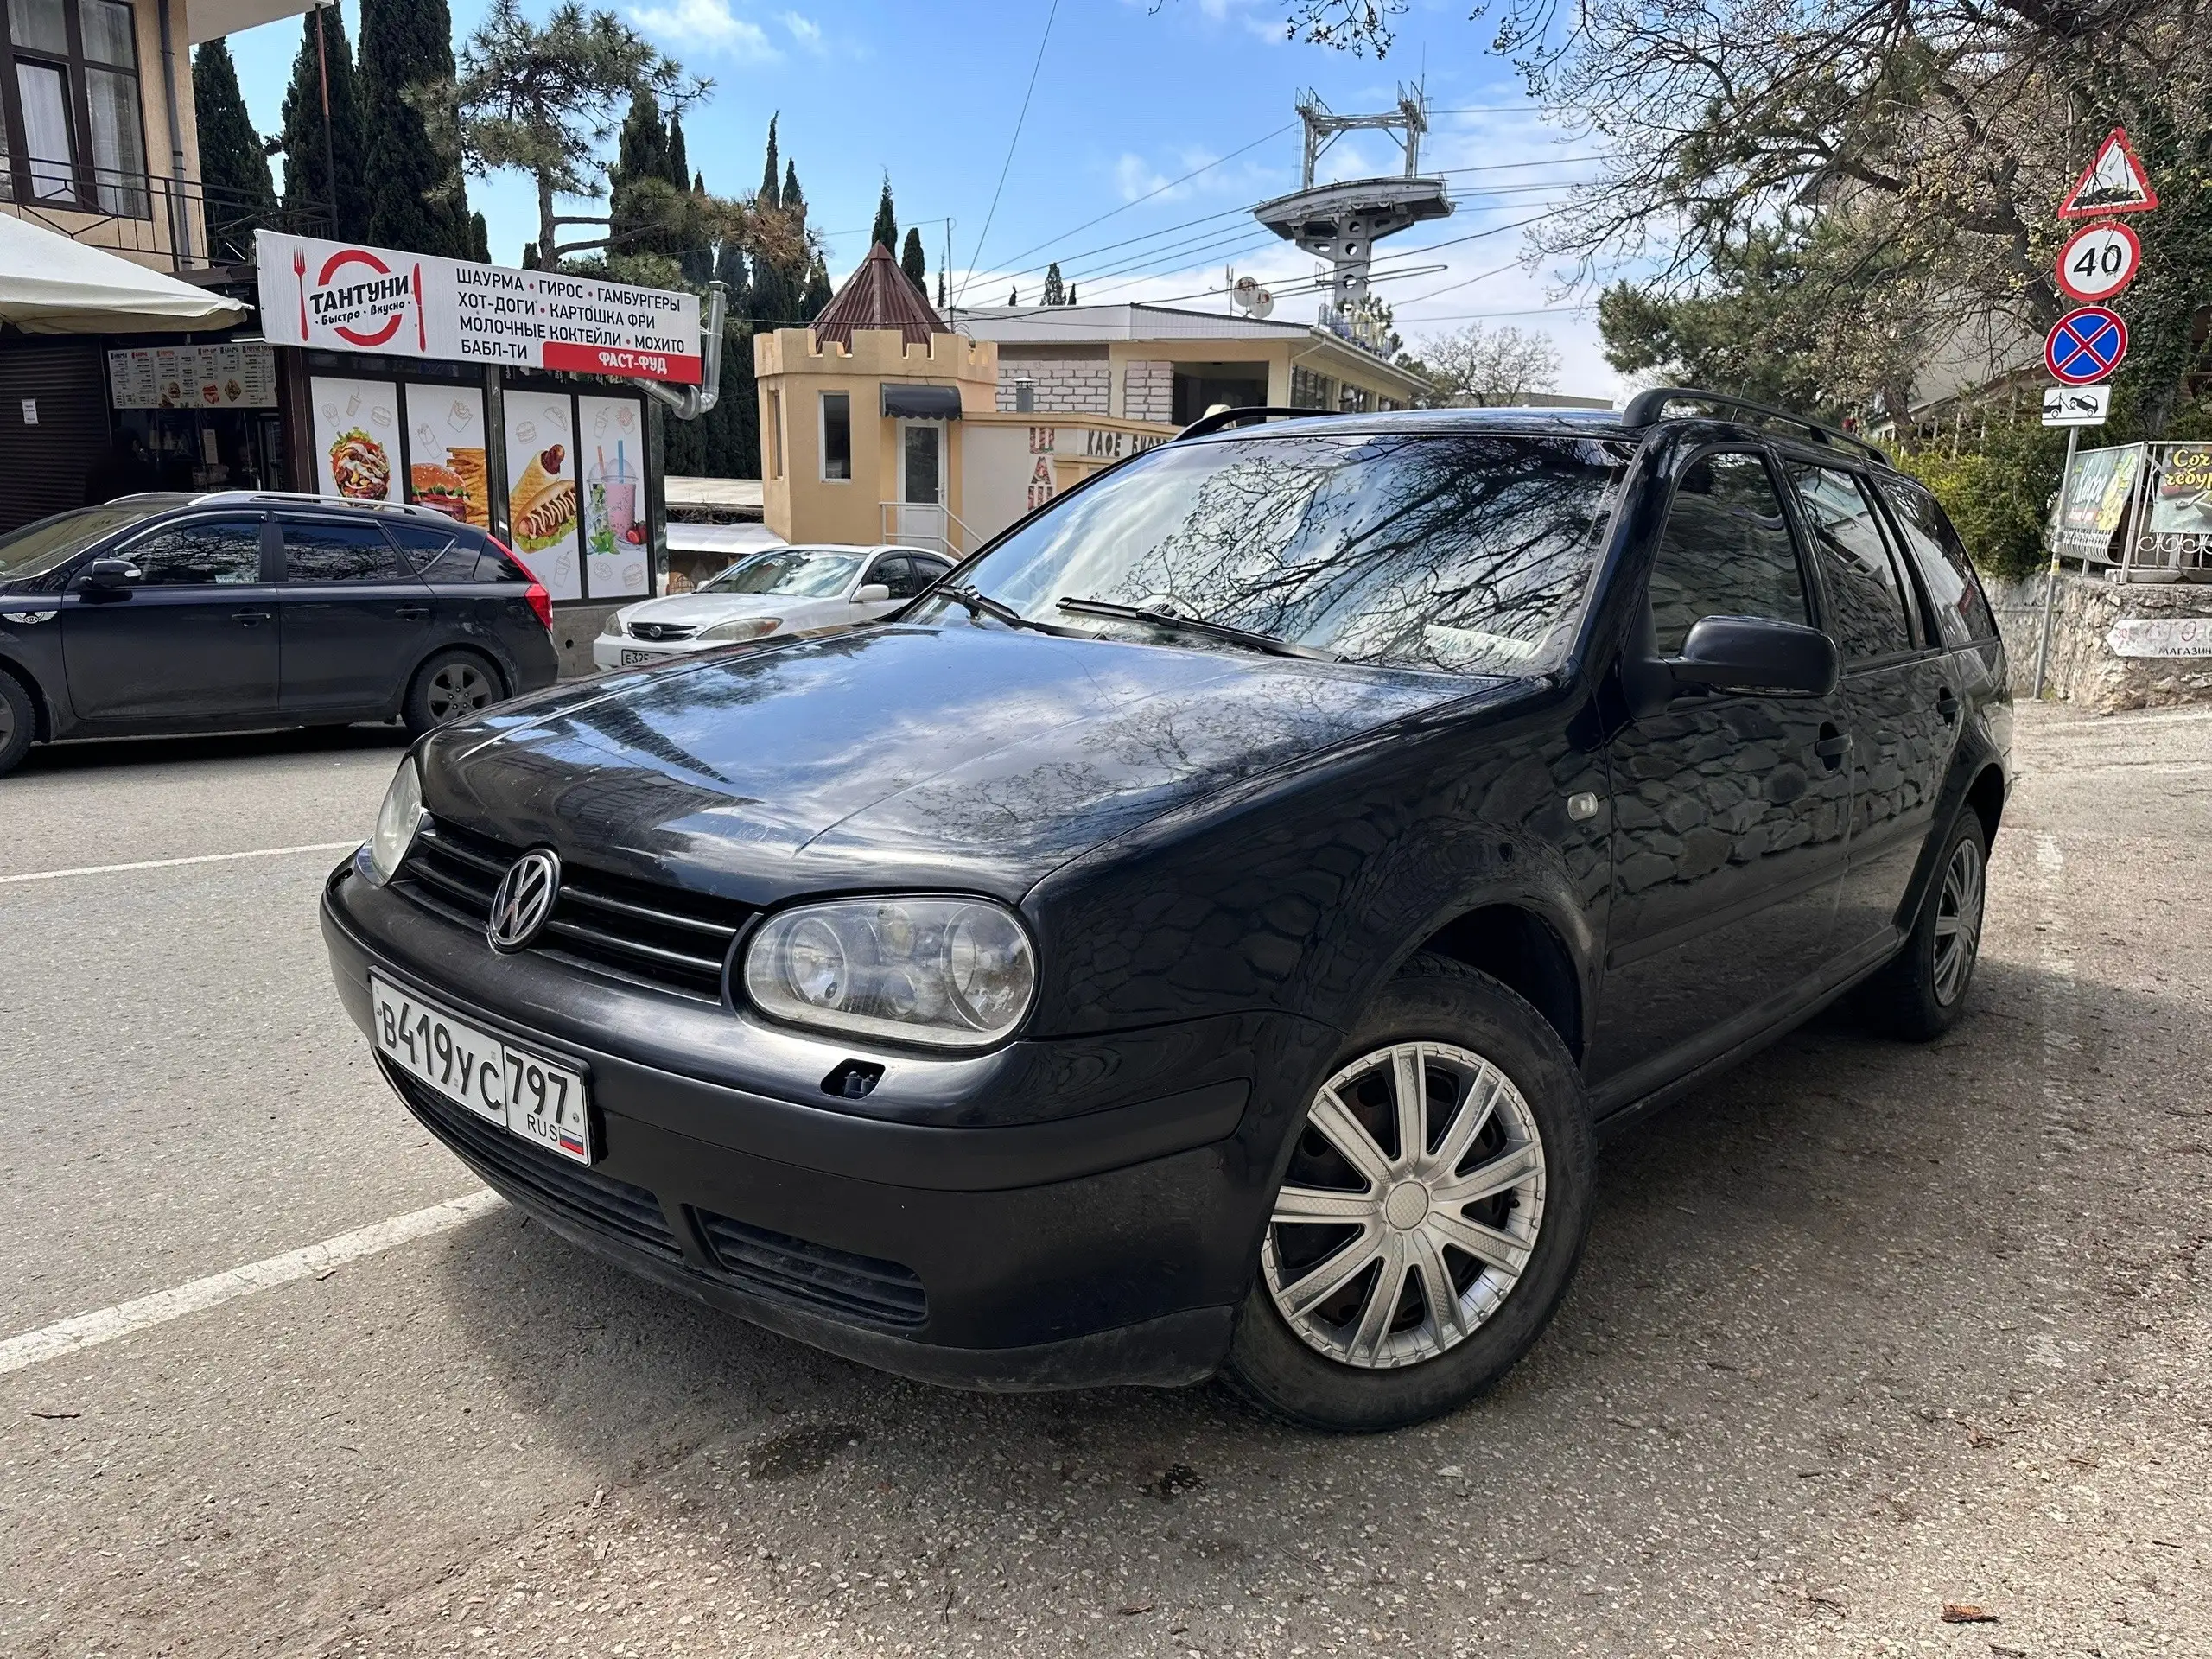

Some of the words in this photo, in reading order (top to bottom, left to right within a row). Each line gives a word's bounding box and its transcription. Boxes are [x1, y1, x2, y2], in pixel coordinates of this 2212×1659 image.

[2073, 245, 2122, 276] 40
[309, 275, 409, 315] ТАНТУНИ
[456, 268, 524, 292] ШАУРМА
[539, 280, 583, 299] ГИРОС
[597, 288, 681, 312] ГАМБУРГЕРЫ
[321, 310, 360, 326] Быстро
[370, 301, 405, 316] Вкусно
[458, 291, 535, 315] ХОТ-ДОГИ
[550, 303, 624, 326] КАРТОШКА
[627, 313, 655, 329] ФРИ
[459, 315, 546, 339] МОЛОЧНЫЕ
[550, 325, 622, 346] КОКТЕЙЛИ
[634, 334, 684, 353] МОХИТО
[461, 339, 527, 359] БАБЛ-ТИ
[598, 352, 667, 375] ФАСТ-ФУД
[1087, 429, 1122, 457] КАФЕ
[2173, 449, 2212, 467] Соч
[505, 1052, 568, 1124] 797
[526, 1113, 558, 1142] RUS
